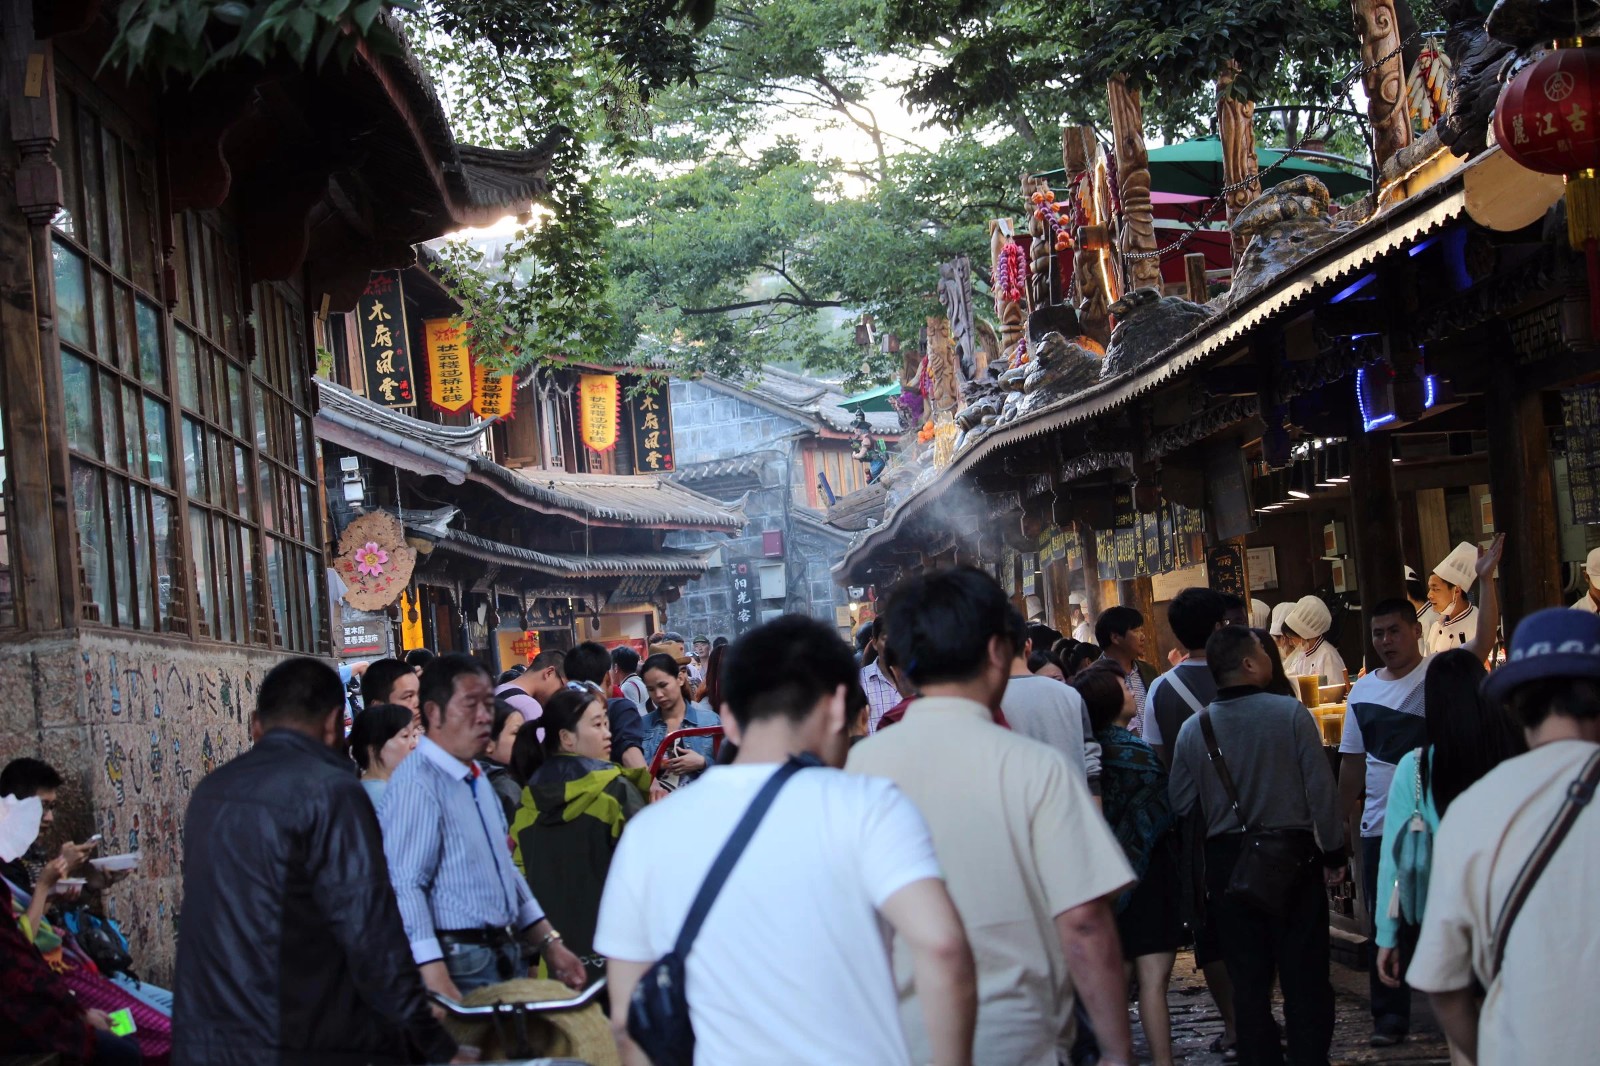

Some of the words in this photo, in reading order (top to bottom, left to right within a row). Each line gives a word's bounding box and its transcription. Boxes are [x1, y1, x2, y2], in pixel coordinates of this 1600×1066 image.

[437, 343, 464, 403] 状元楼过桥米线
